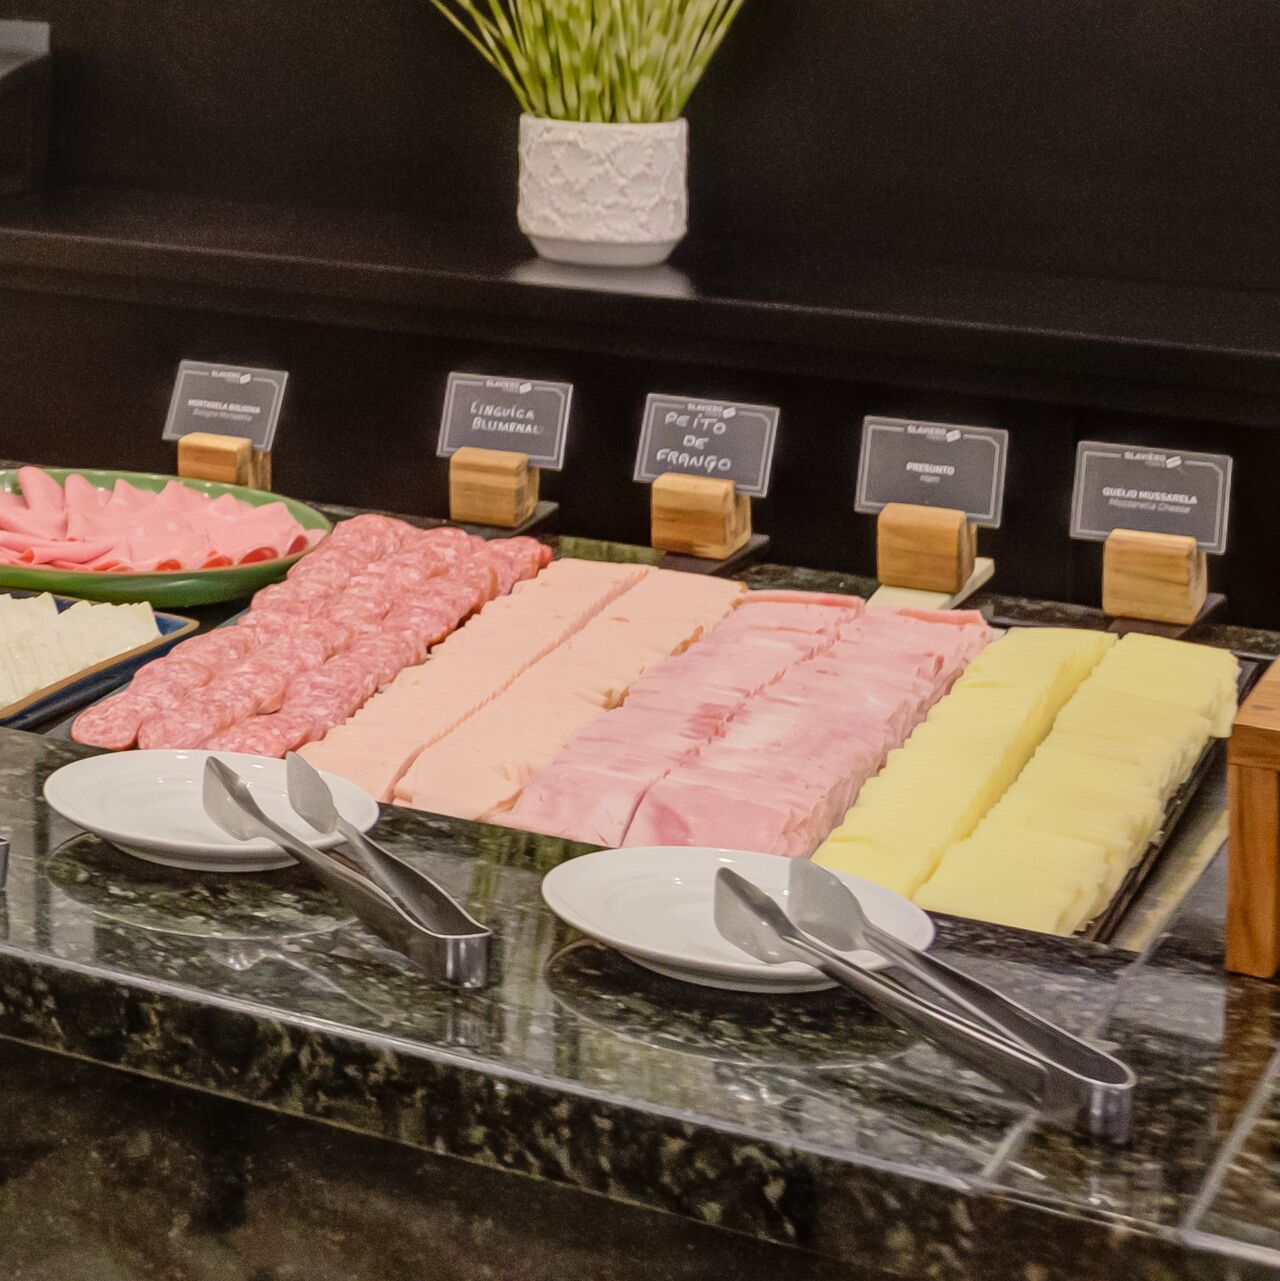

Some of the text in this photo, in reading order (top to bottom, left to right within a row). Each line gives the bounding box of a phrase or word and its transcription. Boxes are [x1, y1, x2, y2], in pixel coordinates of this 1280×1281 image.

[683, 434, 710, 450] DE
[656, 448, 732, 473] FRANGO
[906, 461, 955, 476] PRESUNTO
[1102, 486, 1198, 505] QUEIJO MUSSARELA
